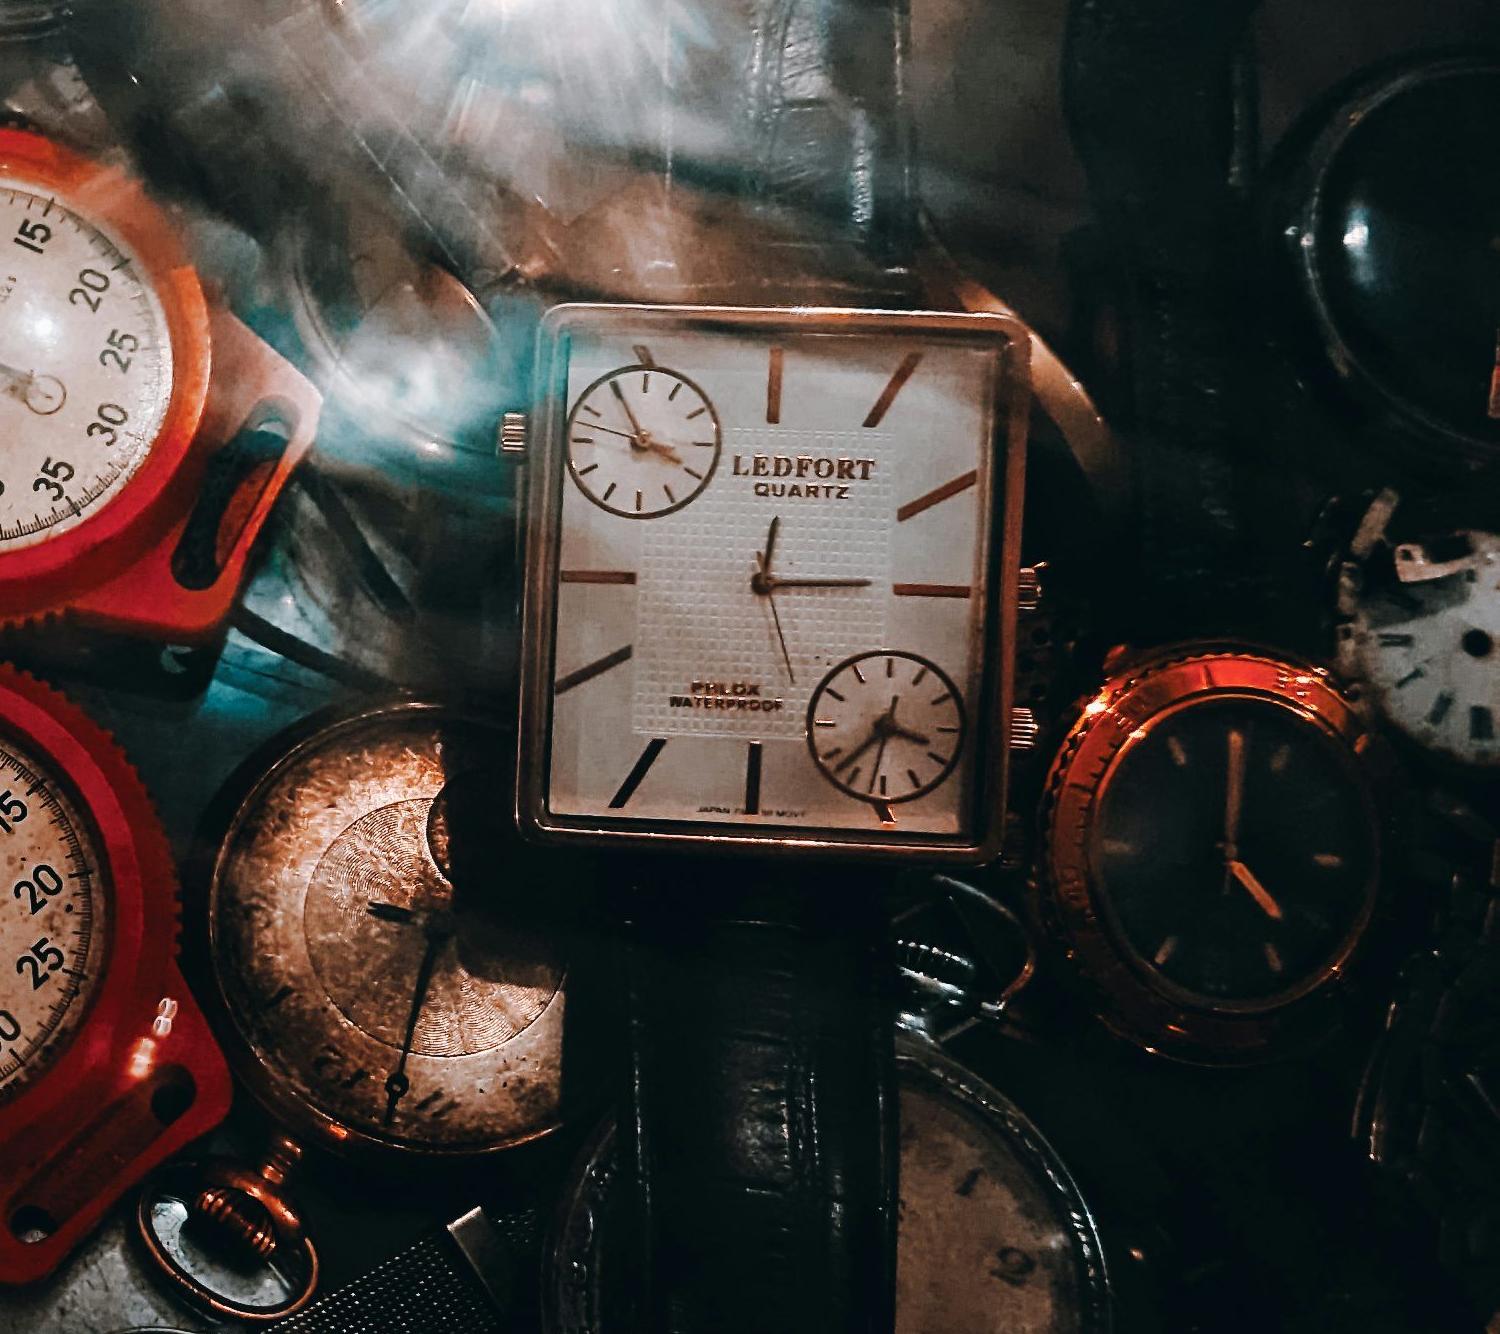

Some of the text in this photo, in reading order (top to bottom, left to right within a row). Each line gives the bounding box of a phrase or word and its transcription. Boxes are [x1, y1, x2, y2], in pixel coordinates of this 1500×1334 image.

[14, 218, 52, 254] 15
[69, 268, 109, 313] 20
[99, 329, 140, 373] 25
[87, 403, 129, 447] 30
[32, 457, 74, 502] 35
[732, 454, 876, 480] LEDFORT
[754, 482, 850, 499] QUARTZ
[669, 696, 783, 712] WATERPROOF
[13, 863, 64, 916] 20
[16, 936, 66, 990] 25
